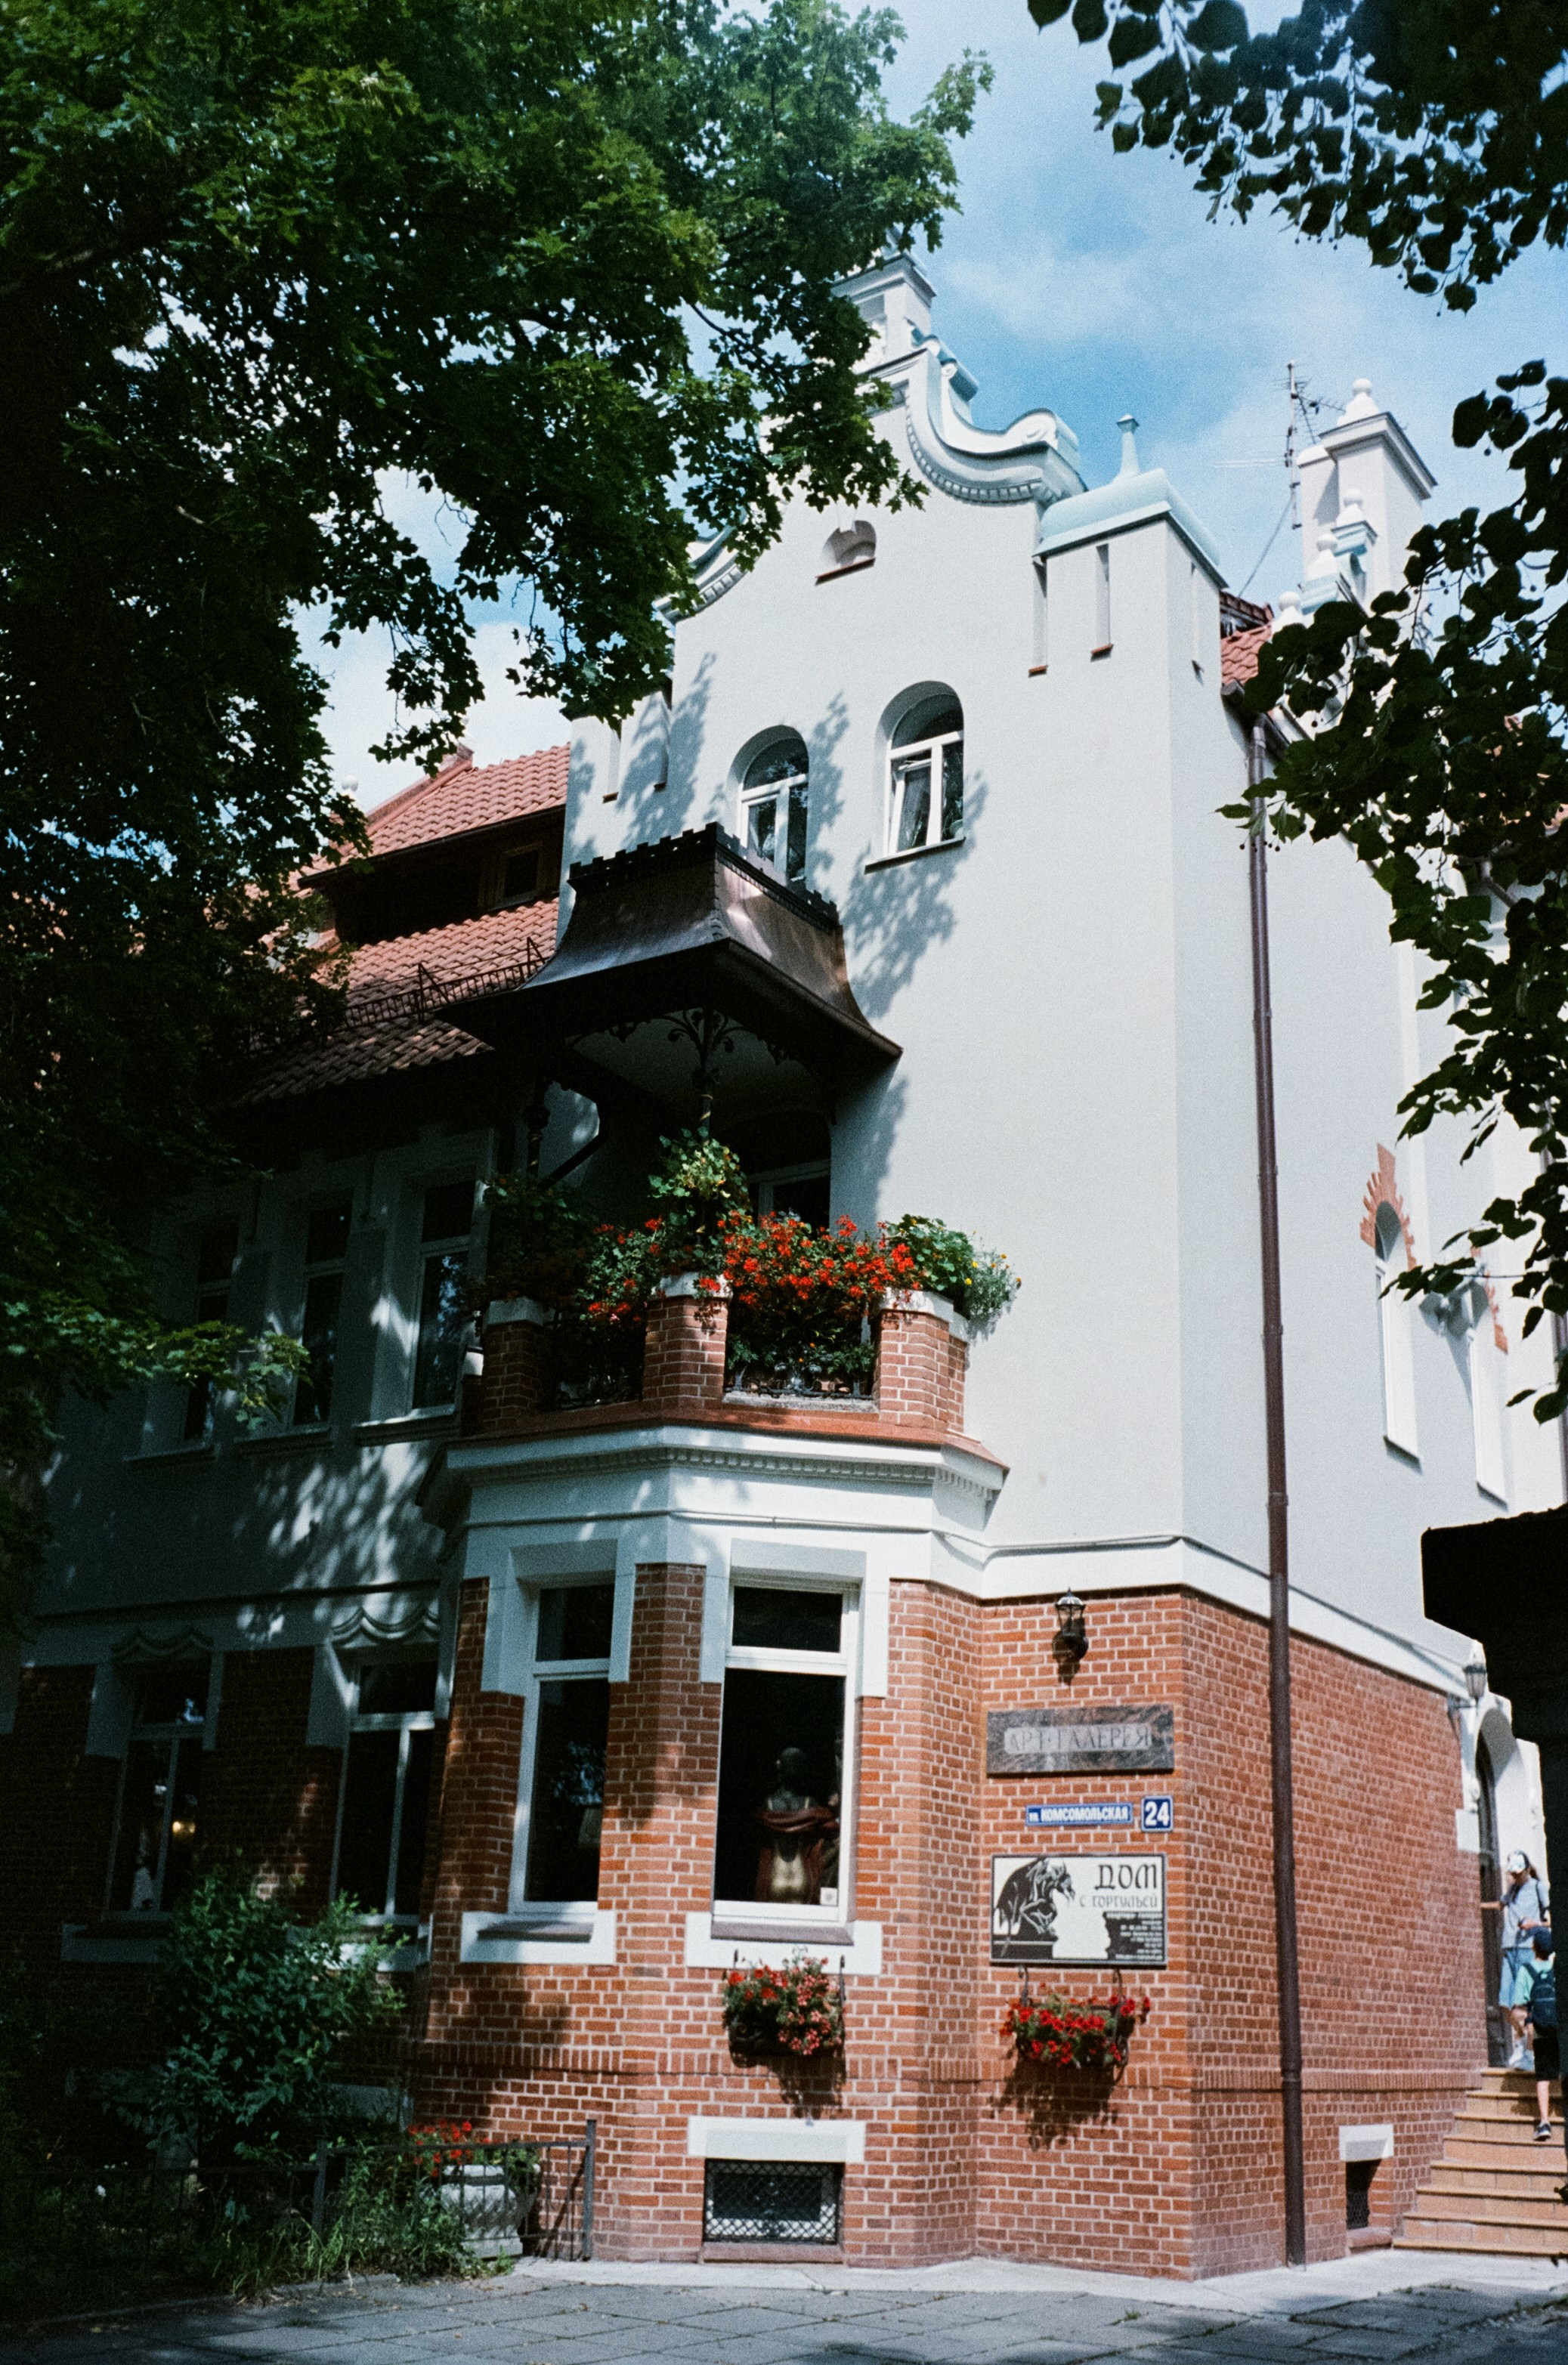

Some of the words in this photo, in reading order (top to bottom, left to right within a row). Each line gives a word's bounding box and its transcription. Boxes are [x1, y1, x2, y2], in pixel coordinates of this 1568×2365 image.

[1041, 1806, 1129, 1822] КОМСОМОЛЬСКАЯ
[1144, 1801, 1171, 1826] 24
[1094, 1863, 1158, 1890] ДОМ
